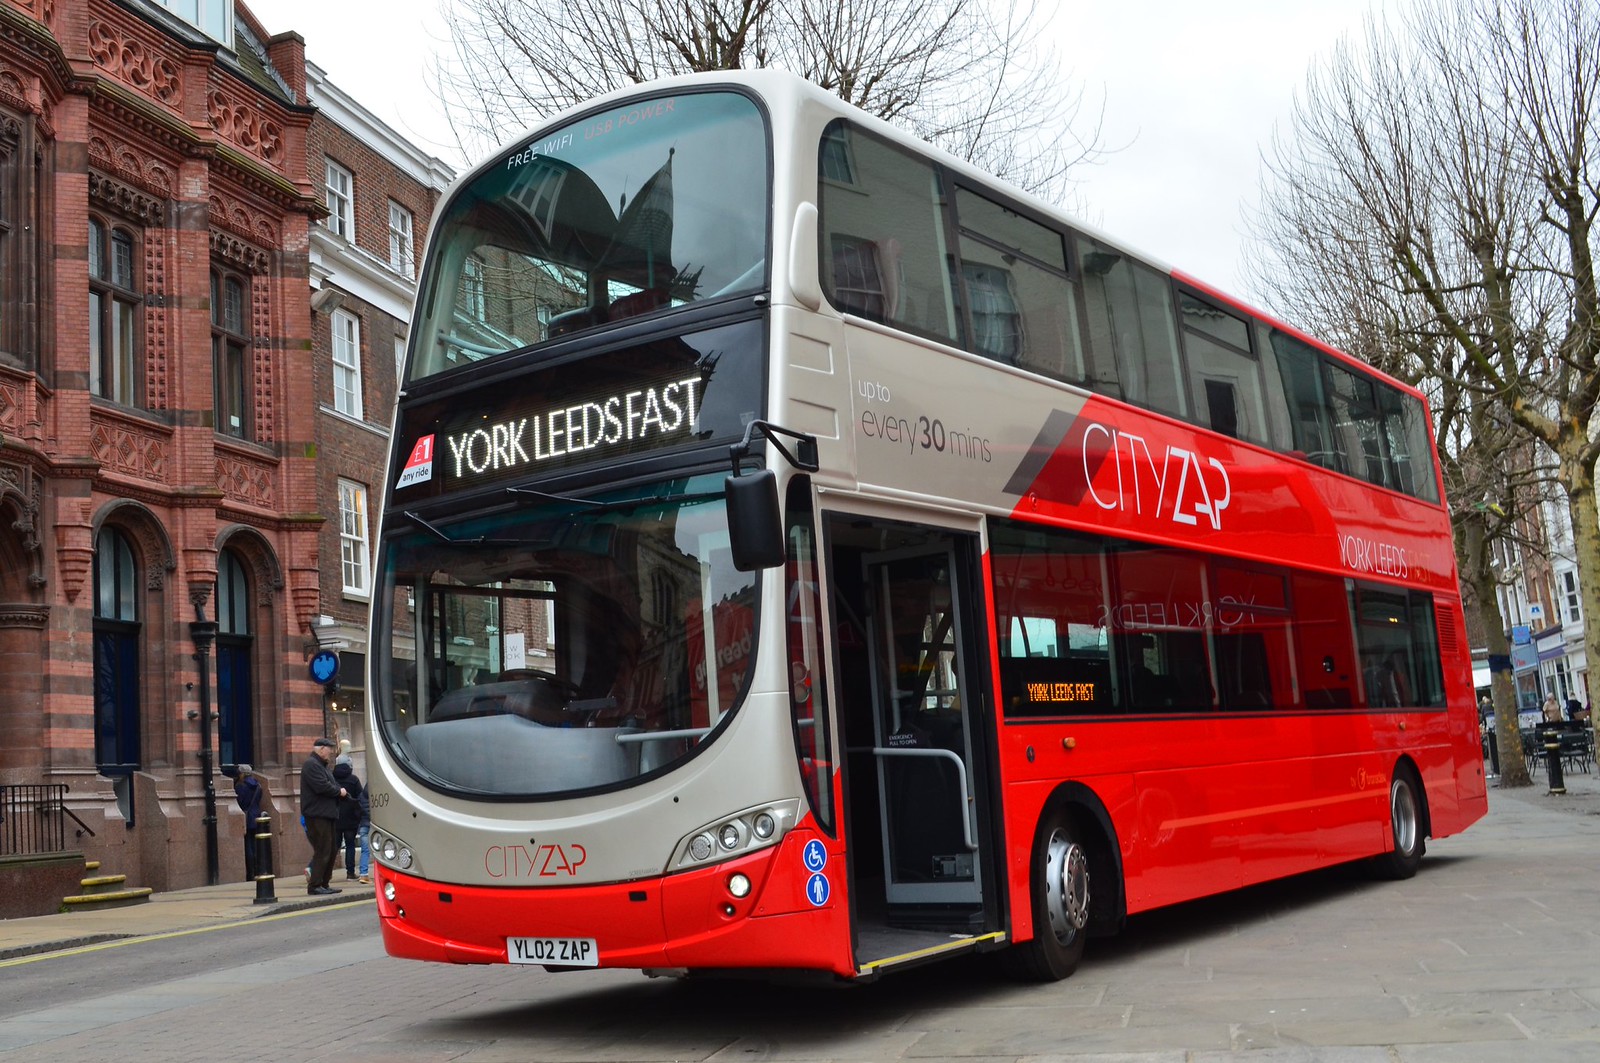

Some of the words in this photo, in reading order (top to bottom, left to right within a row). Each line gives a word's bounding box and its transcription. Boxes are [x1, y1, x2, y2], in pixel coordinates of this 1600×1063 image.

[507, 145, 540, 170] FREE
[543, 133, 574, 155] WIFI
[583, 119, 614, 141] USB
[618, 99, 676, 129] POWER
[858, 379, 875, 404] up
[876, 381, 891, 403] to
[448, 418, 530, 478] YORK
[534, 397, 623, 461] LEEDS
[626, 377, 702, 440] FAST
[861, 410, 917, 456] every
[919, 415, 946, 453] 30
[949, 427, 992, 463] mins
[414, 437, 431, 463] £1
[402, 472, 415, 482] any
[415, 467, 429, 478] ride
[1082, 423, 1231, 531] CITYZAP
[1337, 532, 1374, 573] YORK
[1373, 541, 1408, 579] LEEDS
[1027, 683, 1050, 702] YORK
[1050, 683, 1075, 701] LEEDS
[1075, 683, 1095, 701] FAST
[484, 843, 587, 878] CITYZAP
[514, 939, 555, 960] YL02
[558, 940, 590, 961] ZAP
